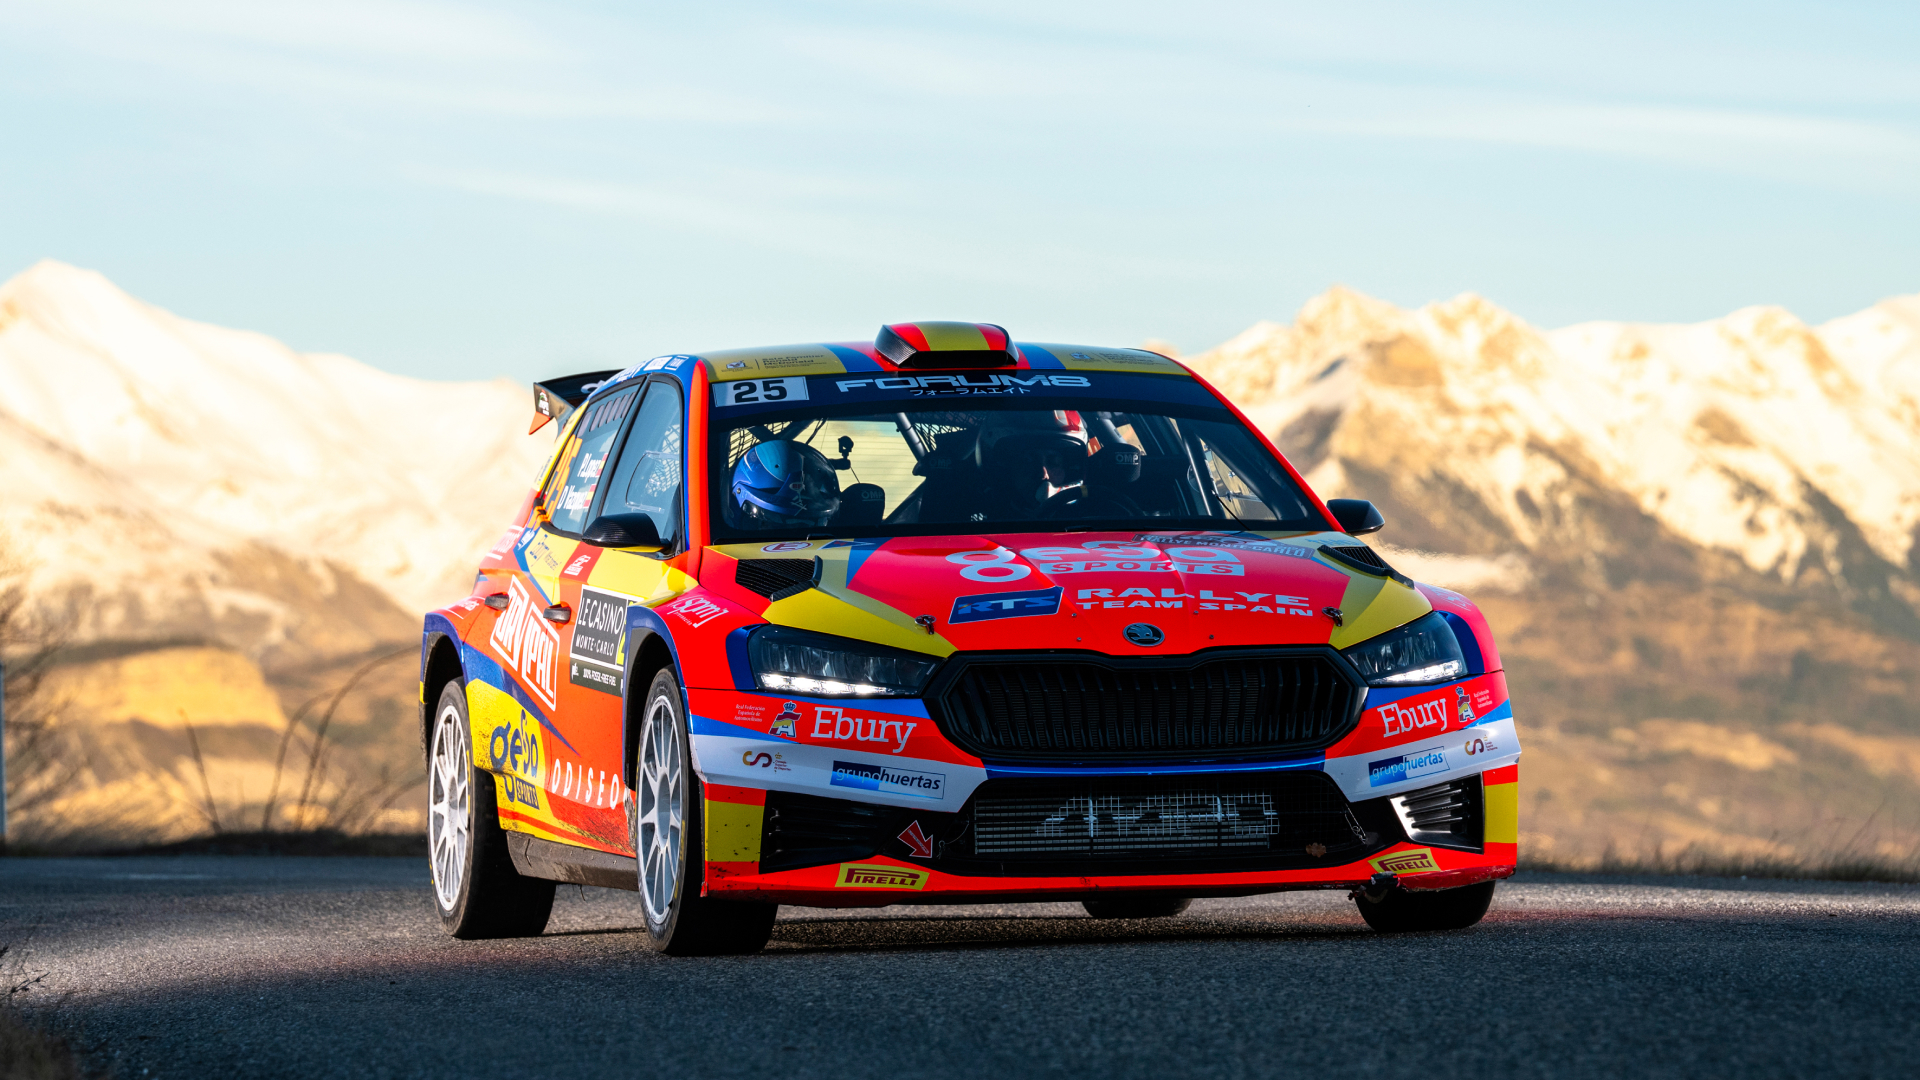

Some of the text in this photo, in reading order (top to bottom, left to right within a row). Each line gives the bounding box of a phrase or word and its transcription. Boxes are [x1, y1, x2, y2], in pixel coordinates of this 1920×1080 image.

[733, 379, 787, 403] 25
[836, 374, 1092, 393] FORUM8
[1050, 560, 1234, 576] SPORTS
[956, 594, 1058, 615] RTS
[1075, 600, 1313, 617] TEAM SPAIN
[1077, 587, 1310, 606] RALLYE
[578, 597, 591, 627] LE
[588, 599, 624, 635] CASINO
[810, 706, 917, 754] Ebury
[1377, 698, 1447, 738] Ebury
[836, 766, 940, 790] grupohuertas
[1372, 752, 1444, 780] grupohuertas
[517, 779, 539, 808] SPORTS
[551, 758, 620, 810] ODISEO
[1377, 853, 1433, 872] PIRELLI
[845, 868, 921, 886] PIRELLI
